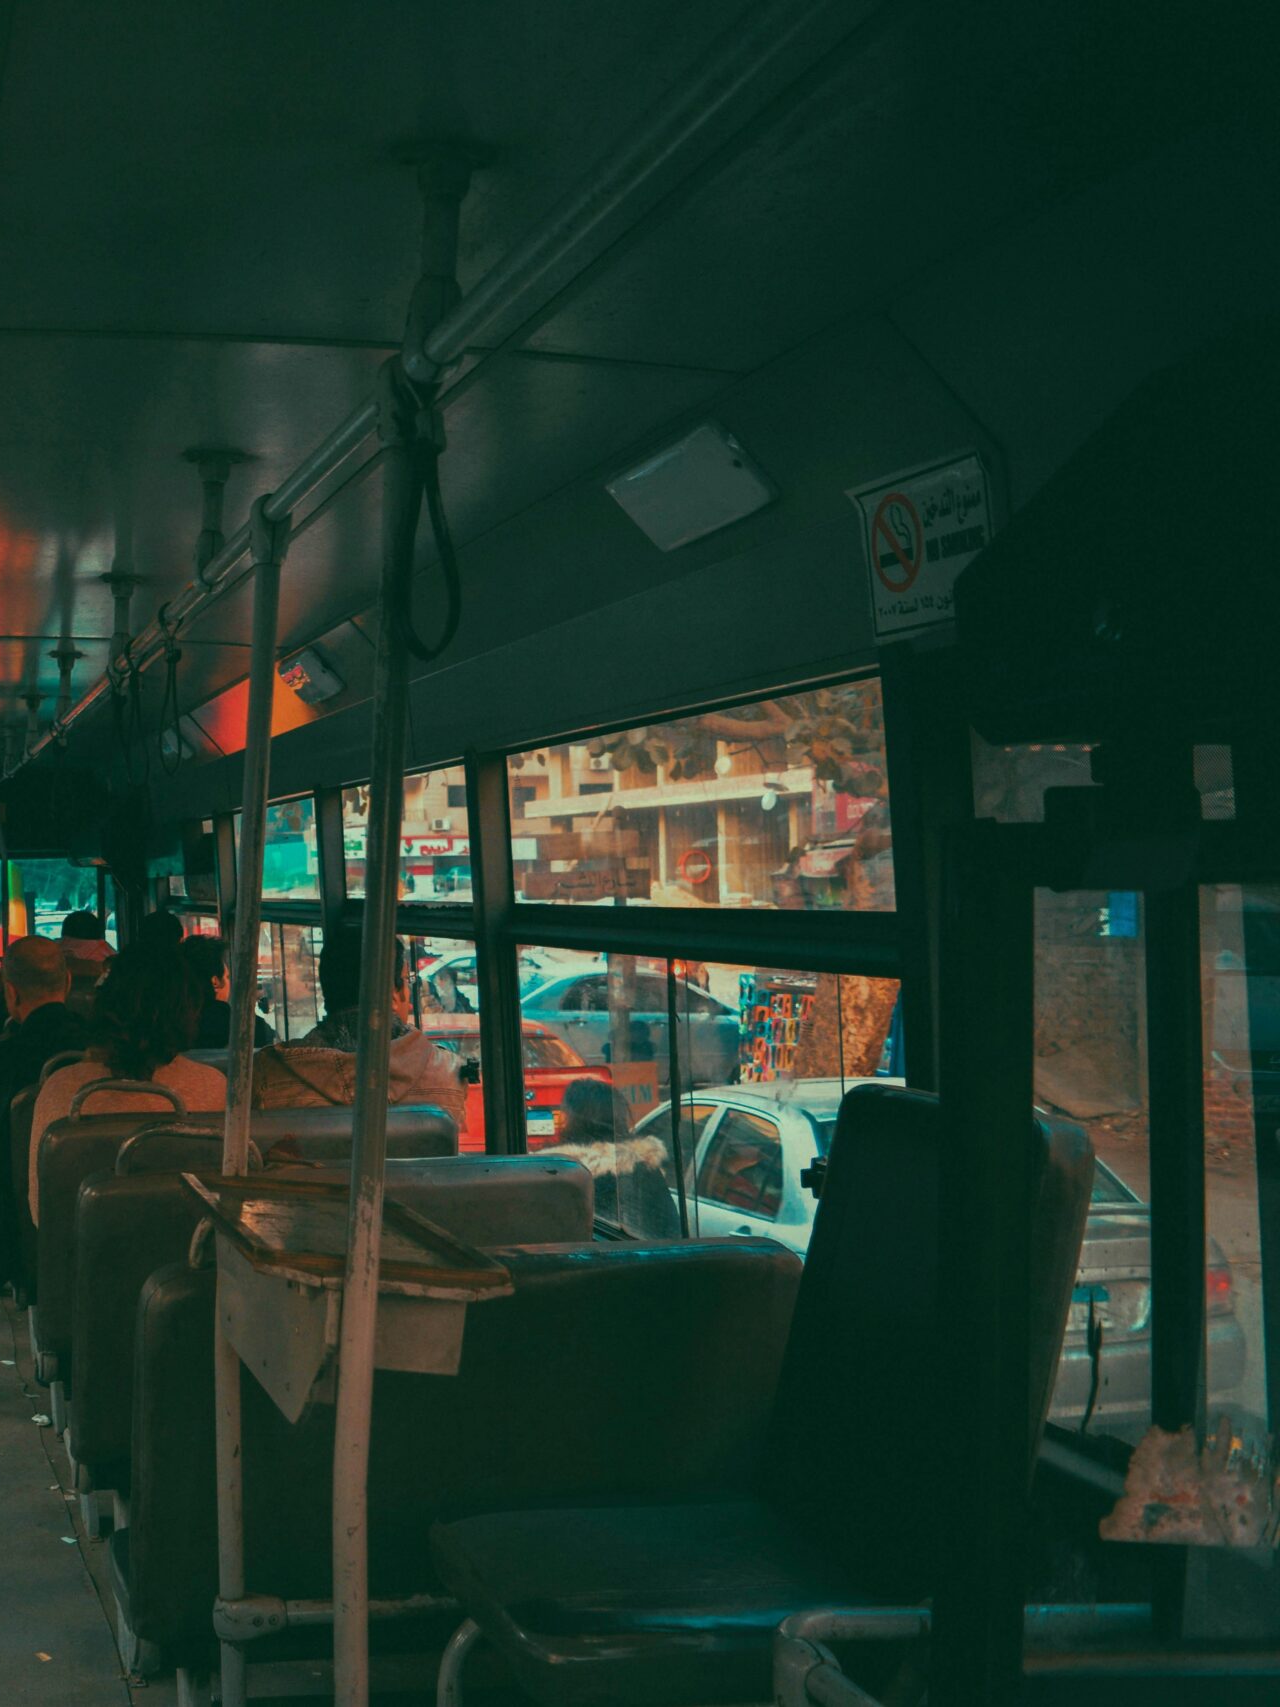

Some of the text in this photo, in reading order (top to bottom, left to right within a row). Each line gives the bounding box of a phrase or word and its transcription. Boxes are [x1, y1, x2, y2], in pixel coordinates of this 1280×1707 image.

[921, 484, 982, 528] ممنوع التدخين
[926, 524, 985, 563] NO SMOKING
[897, 596, 919, 614] لسنة
